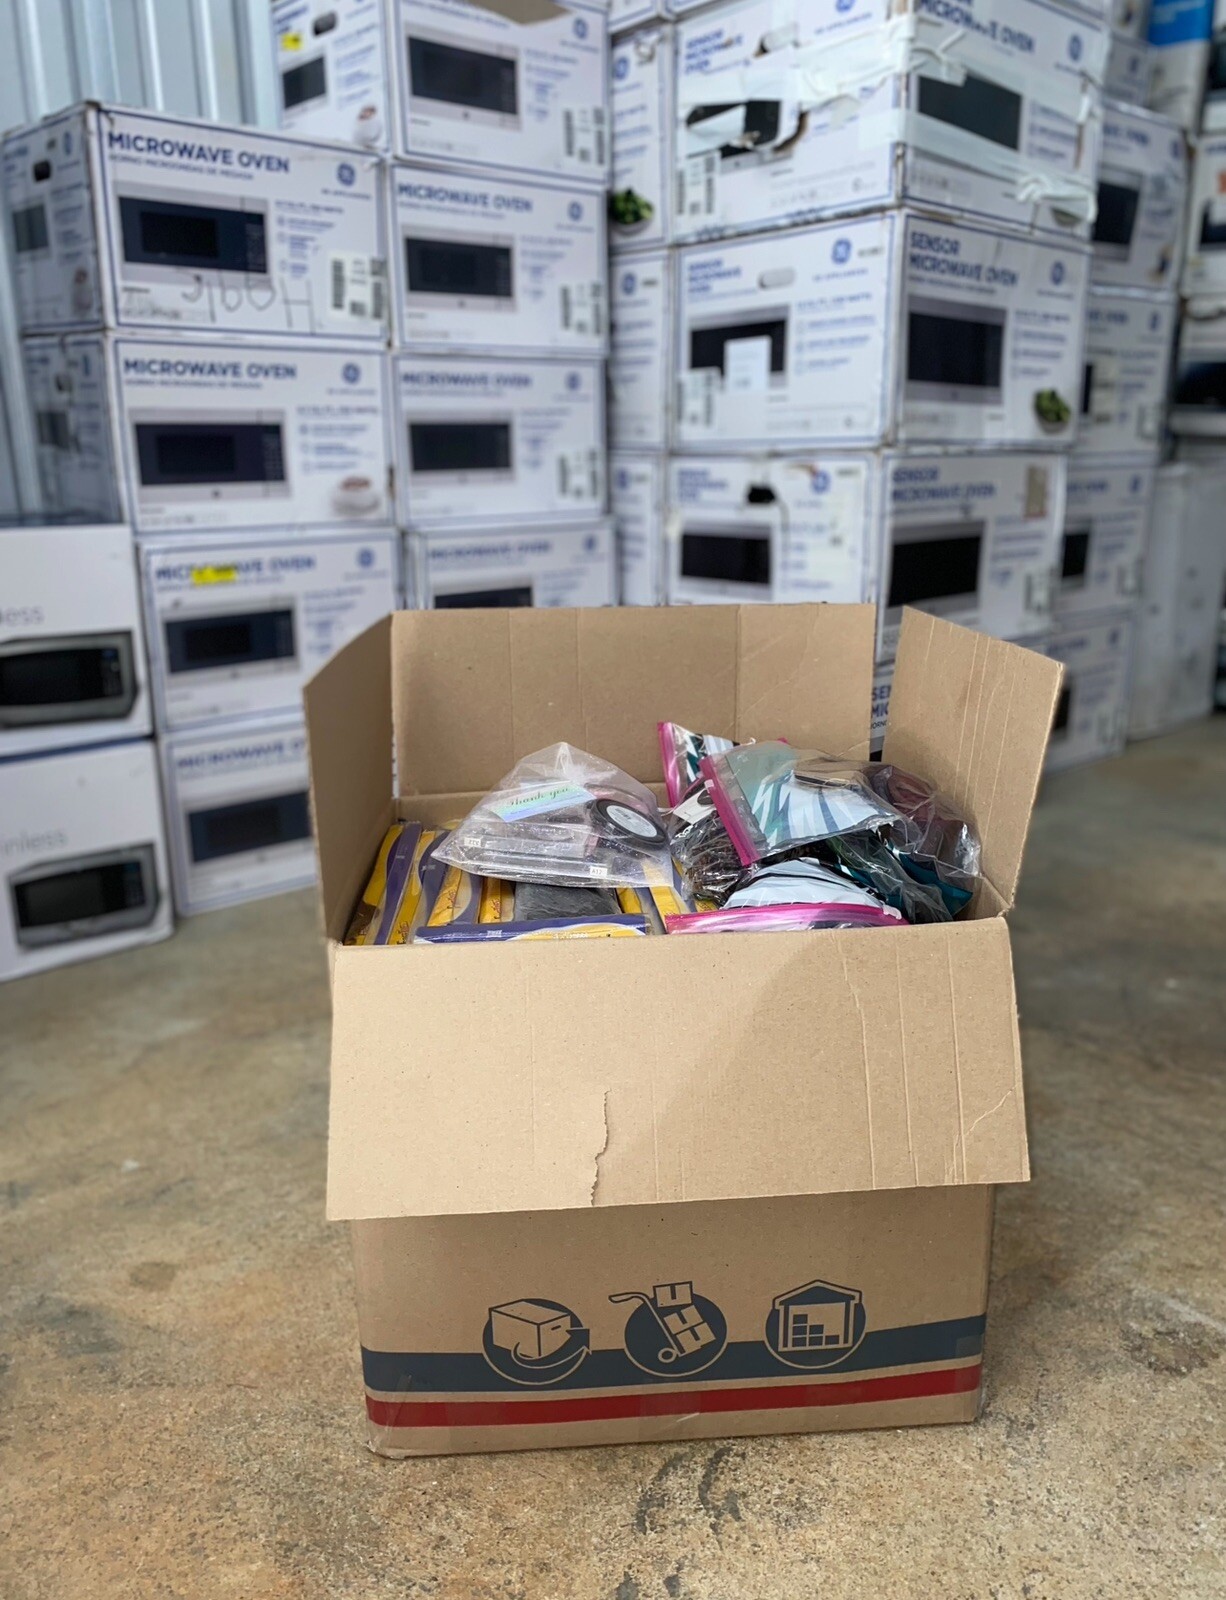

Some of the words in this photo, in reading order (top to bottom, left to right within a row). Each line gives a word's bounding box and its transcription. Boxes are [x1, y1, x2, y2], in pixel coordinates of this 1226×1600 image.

[108, 131, 234, 165] MICROWAVE
[238, 151, 290, 173] OVEN
[398, 183, 489, 208] MICROWAVE
[492, 195, 533, 212] OVEN
[909, 231, 960, 256] SENSOR
[908, 252, 982, 283] MICROWAVE
[985, 267, 1019, 288] OVEN
[123, 358, 241, 378] MICROWAVE
[246, 363, 297, 379] OVEN
[269, 555, 316, 573] OVEN
